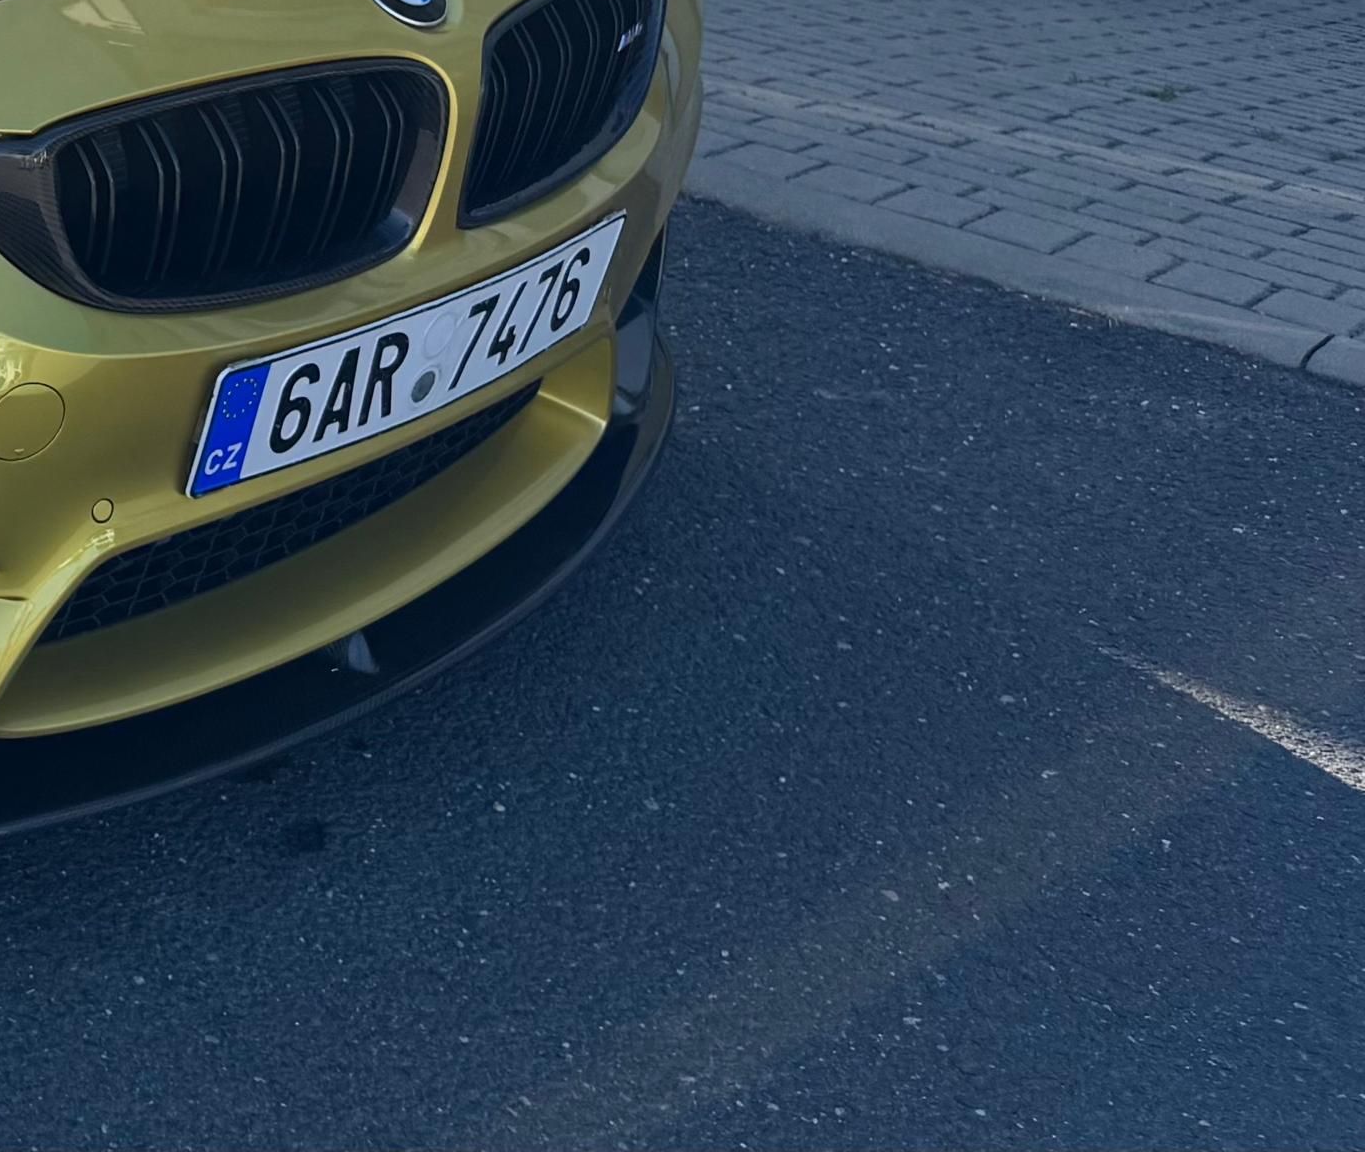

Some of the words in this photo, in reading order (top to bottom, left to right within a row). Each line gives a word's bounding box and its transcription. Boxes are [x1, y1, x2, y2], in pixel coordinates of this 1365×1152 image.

[268, 332, 410, 454] 6AR
[448, 247, 591, 391] 7476
[204, 442, 243, 476] CZ
